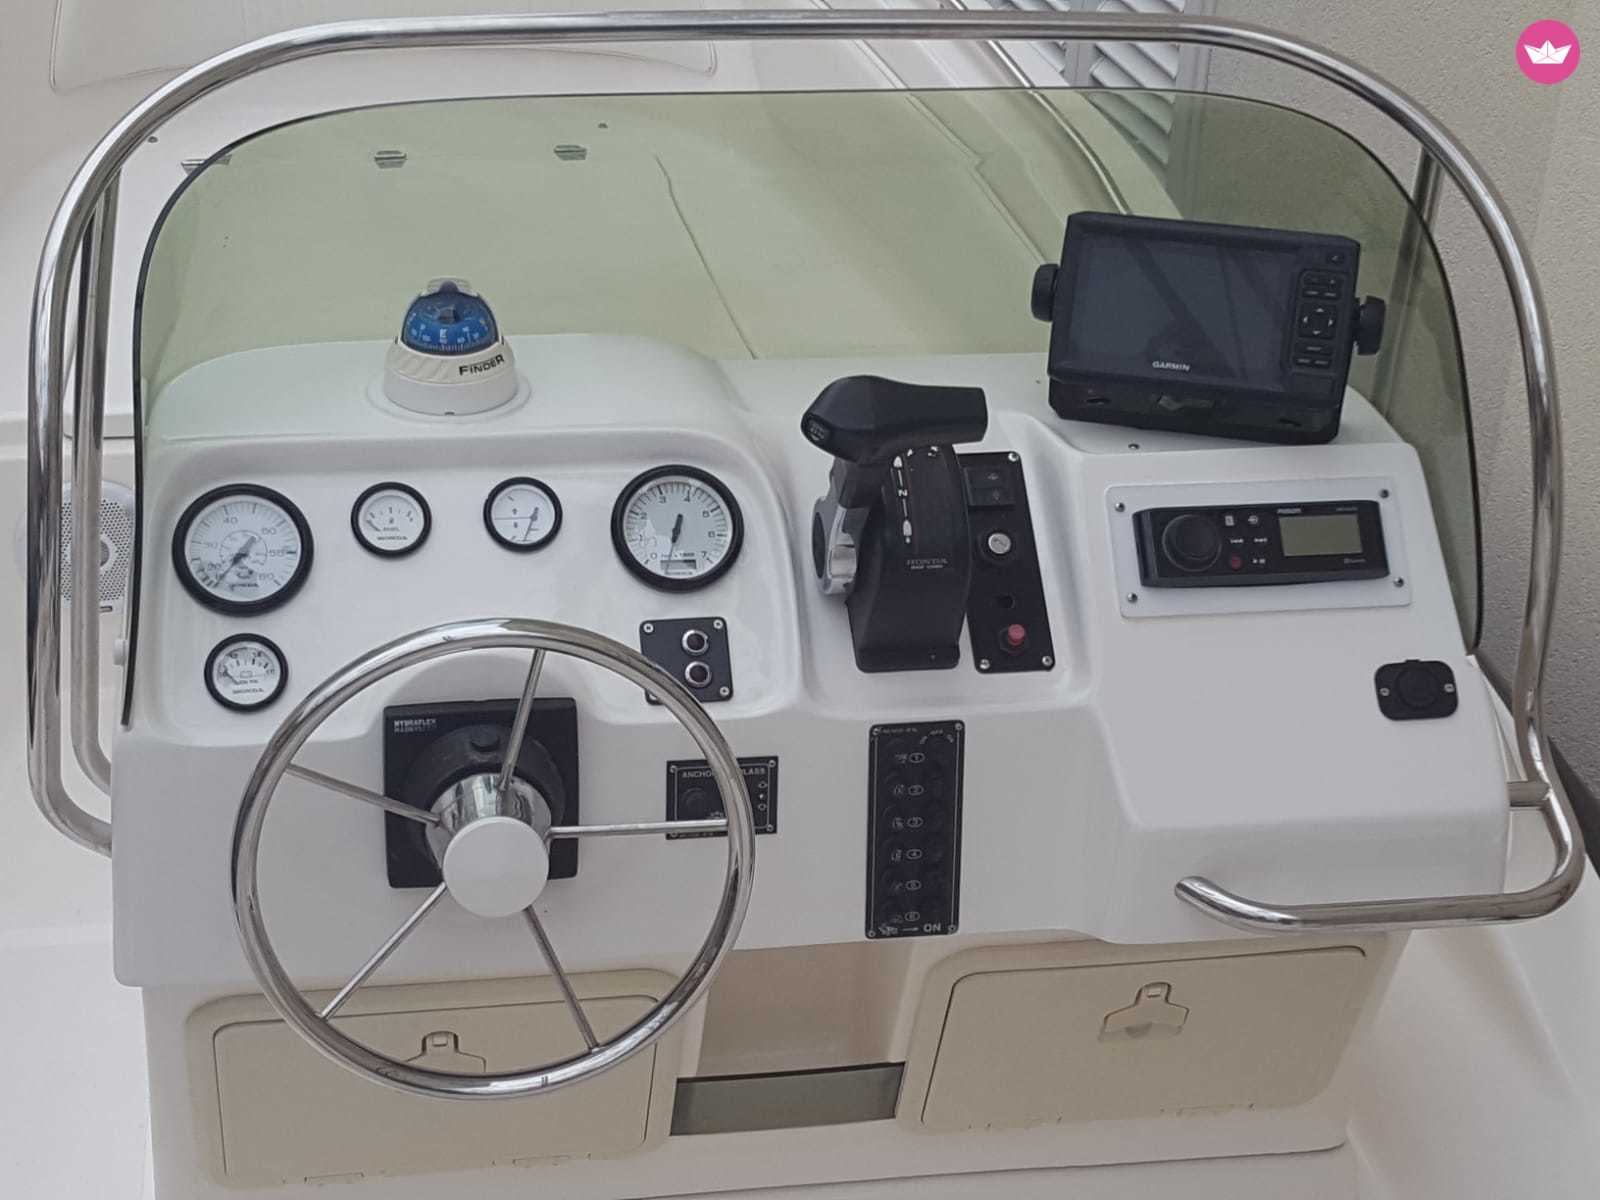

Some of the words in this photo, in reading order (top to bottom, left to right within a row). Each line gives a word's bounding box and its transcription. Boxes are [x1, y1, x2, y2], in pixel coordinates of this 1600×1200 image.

[459, 354, 505, 376] FINDER
[1152, 360, 1190, 372] GARMIN
[923, 923, 941, 933] ON
